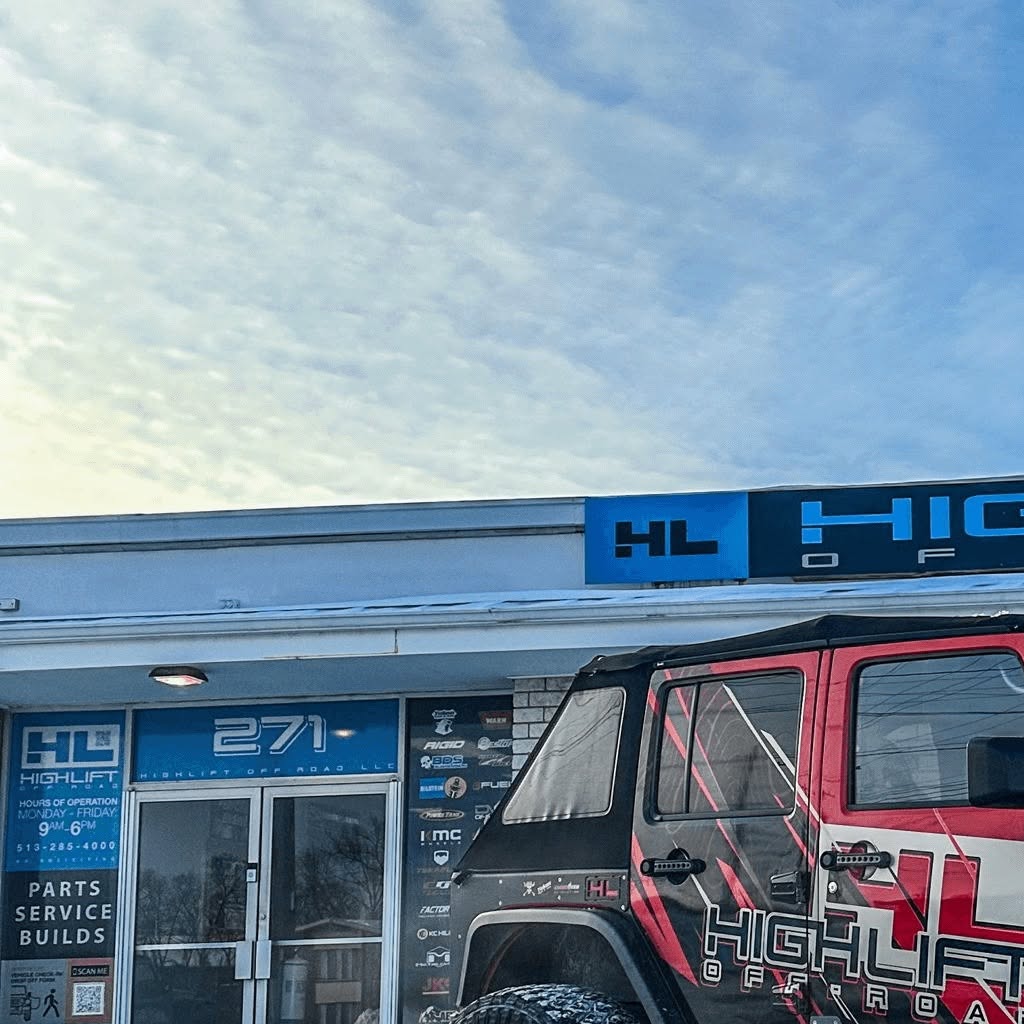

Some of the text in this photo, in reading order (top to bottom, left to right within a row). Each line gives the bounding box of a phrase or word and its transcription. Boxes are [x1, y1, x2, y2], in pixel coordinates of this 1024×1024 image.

[615, 519, 719, 558] HL
[213, 714, 326, 757] 271
[20, 771, 118, 784] HIGHLIFT
[140, 770, 230, 779] HIGHLIFT
[247, 767, 281, 776] OFF
[297, 765, 344, 774] ROAD
[19, 797, 118, 808] HOURS OF OPERATION
[17, 808, 67, 819] MONDAY
[76, 807, 116, 818] FRIDAY
[16, 841, 115, 853] 513-285-4000
[28, 880, 101, 898] PARTS
[15, 903, 112, 922] SERVICE
[19, 927, 105, 946] BUILDS
[77, 967, 108, 976] SCAN ME
